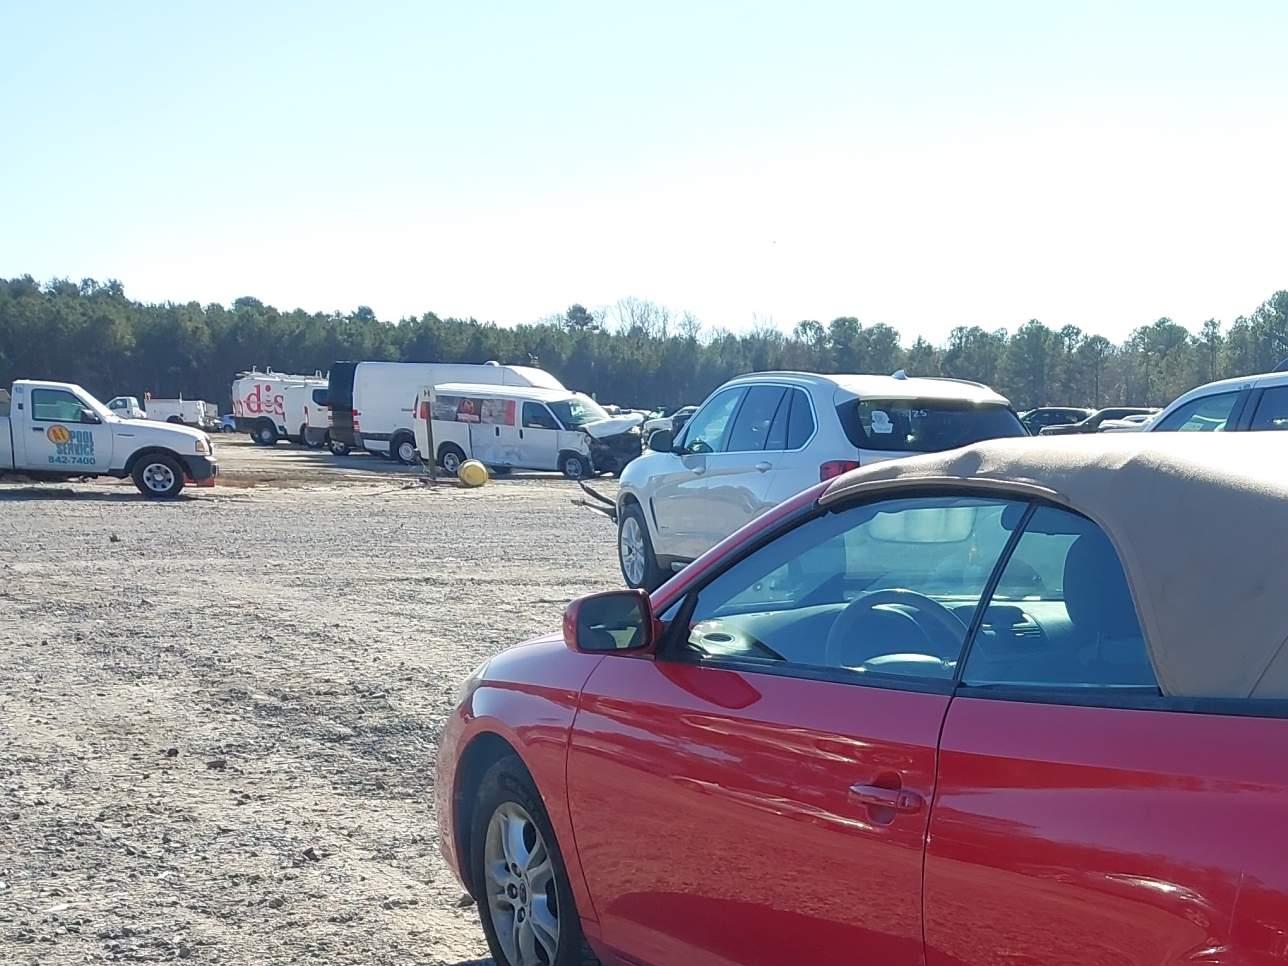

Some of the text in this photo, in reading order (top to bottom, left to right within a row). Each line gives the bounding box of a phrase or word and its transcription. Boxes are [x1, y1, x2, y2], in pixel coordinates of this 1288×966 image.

[70, 430, 94, 443] POOL
[56, 443, 95, 456] SERVICE
[47, 455, 96, 465] 842-7400
